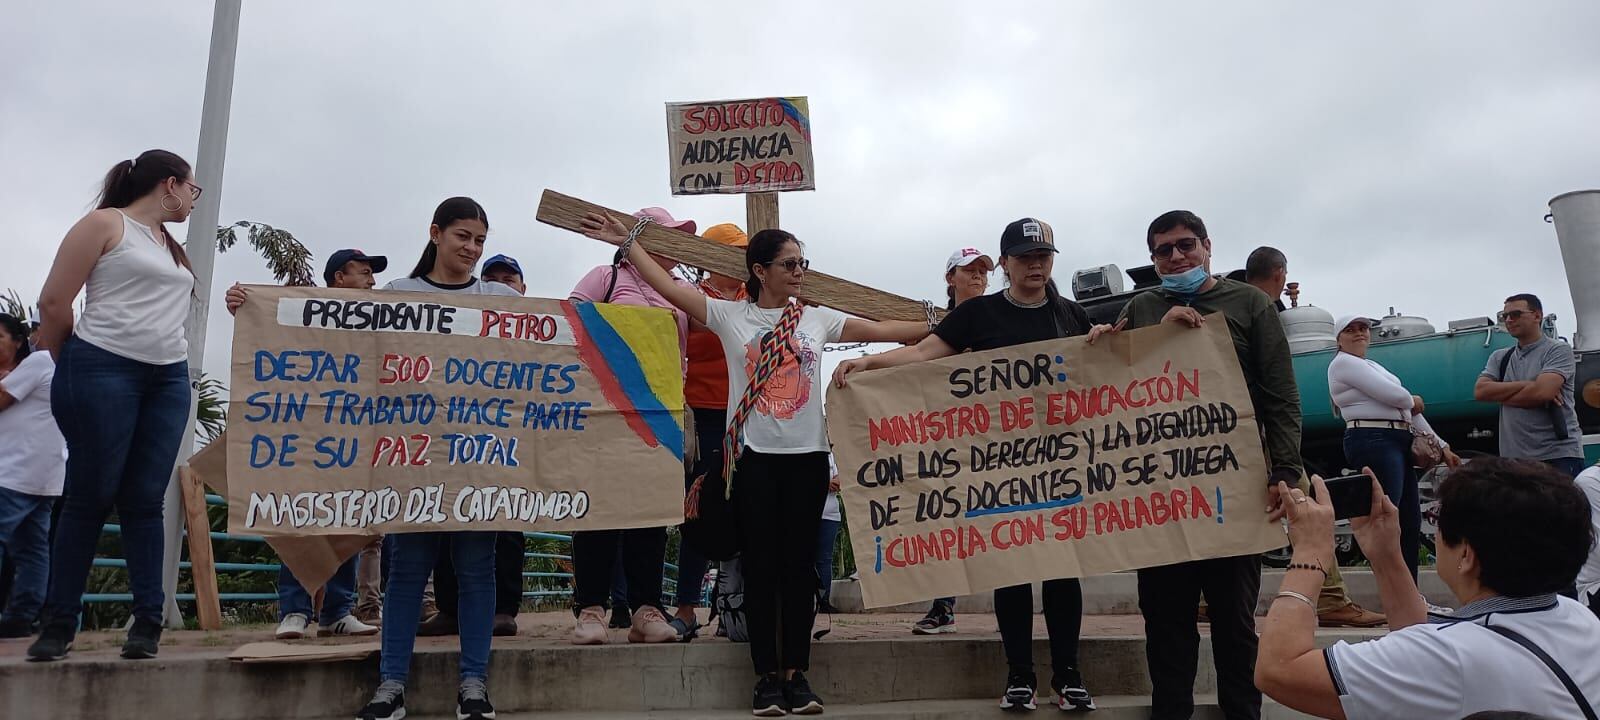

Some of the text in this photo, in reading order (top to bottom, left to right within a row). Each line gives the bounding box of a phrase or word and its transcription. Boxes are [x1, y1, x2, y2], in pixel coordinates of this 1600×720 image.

[683, 103, 784, 134] SOLICITO
[682, 132, 793, 166] AUDIENCIA
[679, 162, 804, 191] CON PETRO
[303, 300, 558, 341] PRESIDENTE PETRO
[254, 350, 581, 394] DEJAR 500 DOCENTES
[245, 392, 592, 431] SIN TRABAJO HACE PARTE
[868, 360, 1200, 451] MINISTRO DE EDUCACIÓN
[250, 433, 520, 469] DE SU PAZ TOTAL
[857, 402, 1238, 488] CON LOS DERECHOS Y LA DIGNIDAD
[245, 484, 590, 528] MAGISTERIO DEL CATATUMBO
[870, 443, 1239, 530] DE LOS DOCENTES NO SE JUEGA
[991, 515, 1046, 551] CON
[1054, 505, 1089, 541] SU
